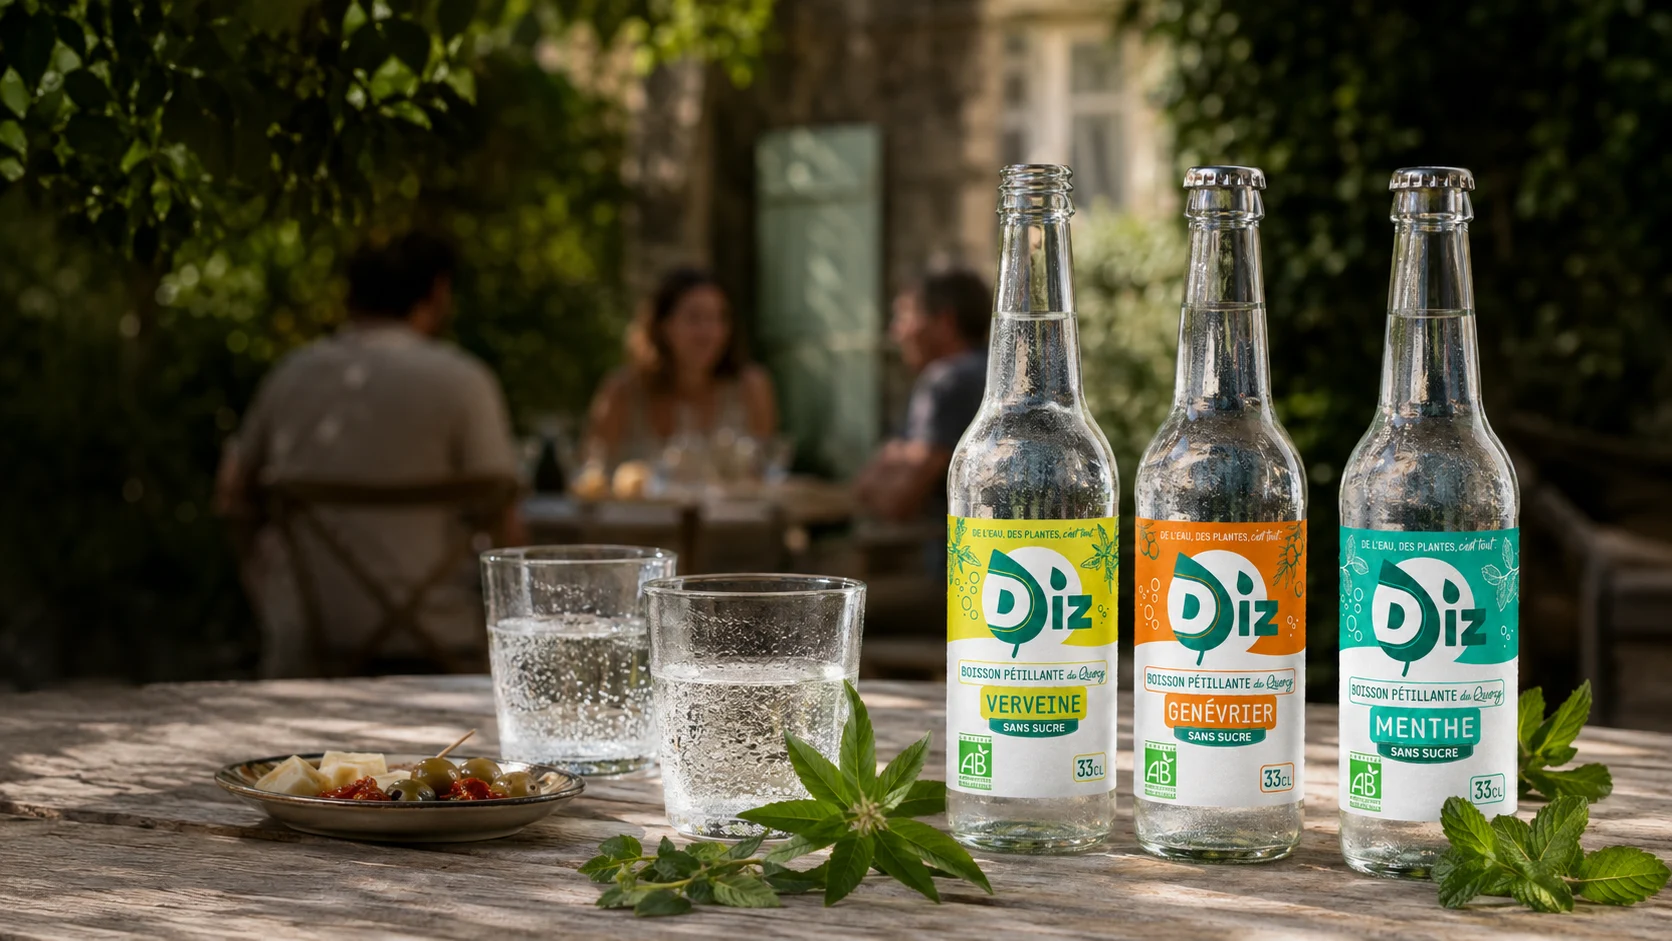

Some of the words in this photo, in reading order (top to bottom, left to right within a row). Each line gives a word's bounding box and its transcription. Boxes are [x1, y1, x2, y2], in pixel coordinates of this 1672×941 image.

[972, 529, 981, 537] DE
[1007, 530, 1022, 538] DES
[1160, 531, 1168, 540] DE
[1170, 531, 1193, 542] L'EAU,
[1195, 532, 1211, 541] DES
[1362, 540, 1370, 549] DE
[1399, 542, 1414, 550] DES
[961, 666, 1000, 679] BOISSON
[1004, 667, 1064, 681] PÉTILLANTE
[1147, 673, 1184, 687] BOISSON
[1189, 675, 1250, 689] PÉTILLANTE
[1352, 684, 1388, 699] BOISSON
[1392, 686, 1457, 701] PÉTILLANTE
[987, 695, 1080, 714] VERVEINE
[1169, 698, 1272, 723] GENÉVRIER
[1003, 723, 1029, 732] SANS
[1032, 723, 1065, 732] SUCRE
[1376, 715, 1474, 739] MENTHE
[1188, 731, 1215, 741] SANS
[1218, 732, 1251, 742] SUCRE
[1391, 747, 1419, 757] SANS
[1422, 748, 1458, 758] SUCRE
[961, 752, 987, 775] AB
[1147, 761, 1171, 784] AB
[1352, 773, 1376, 796] AB
